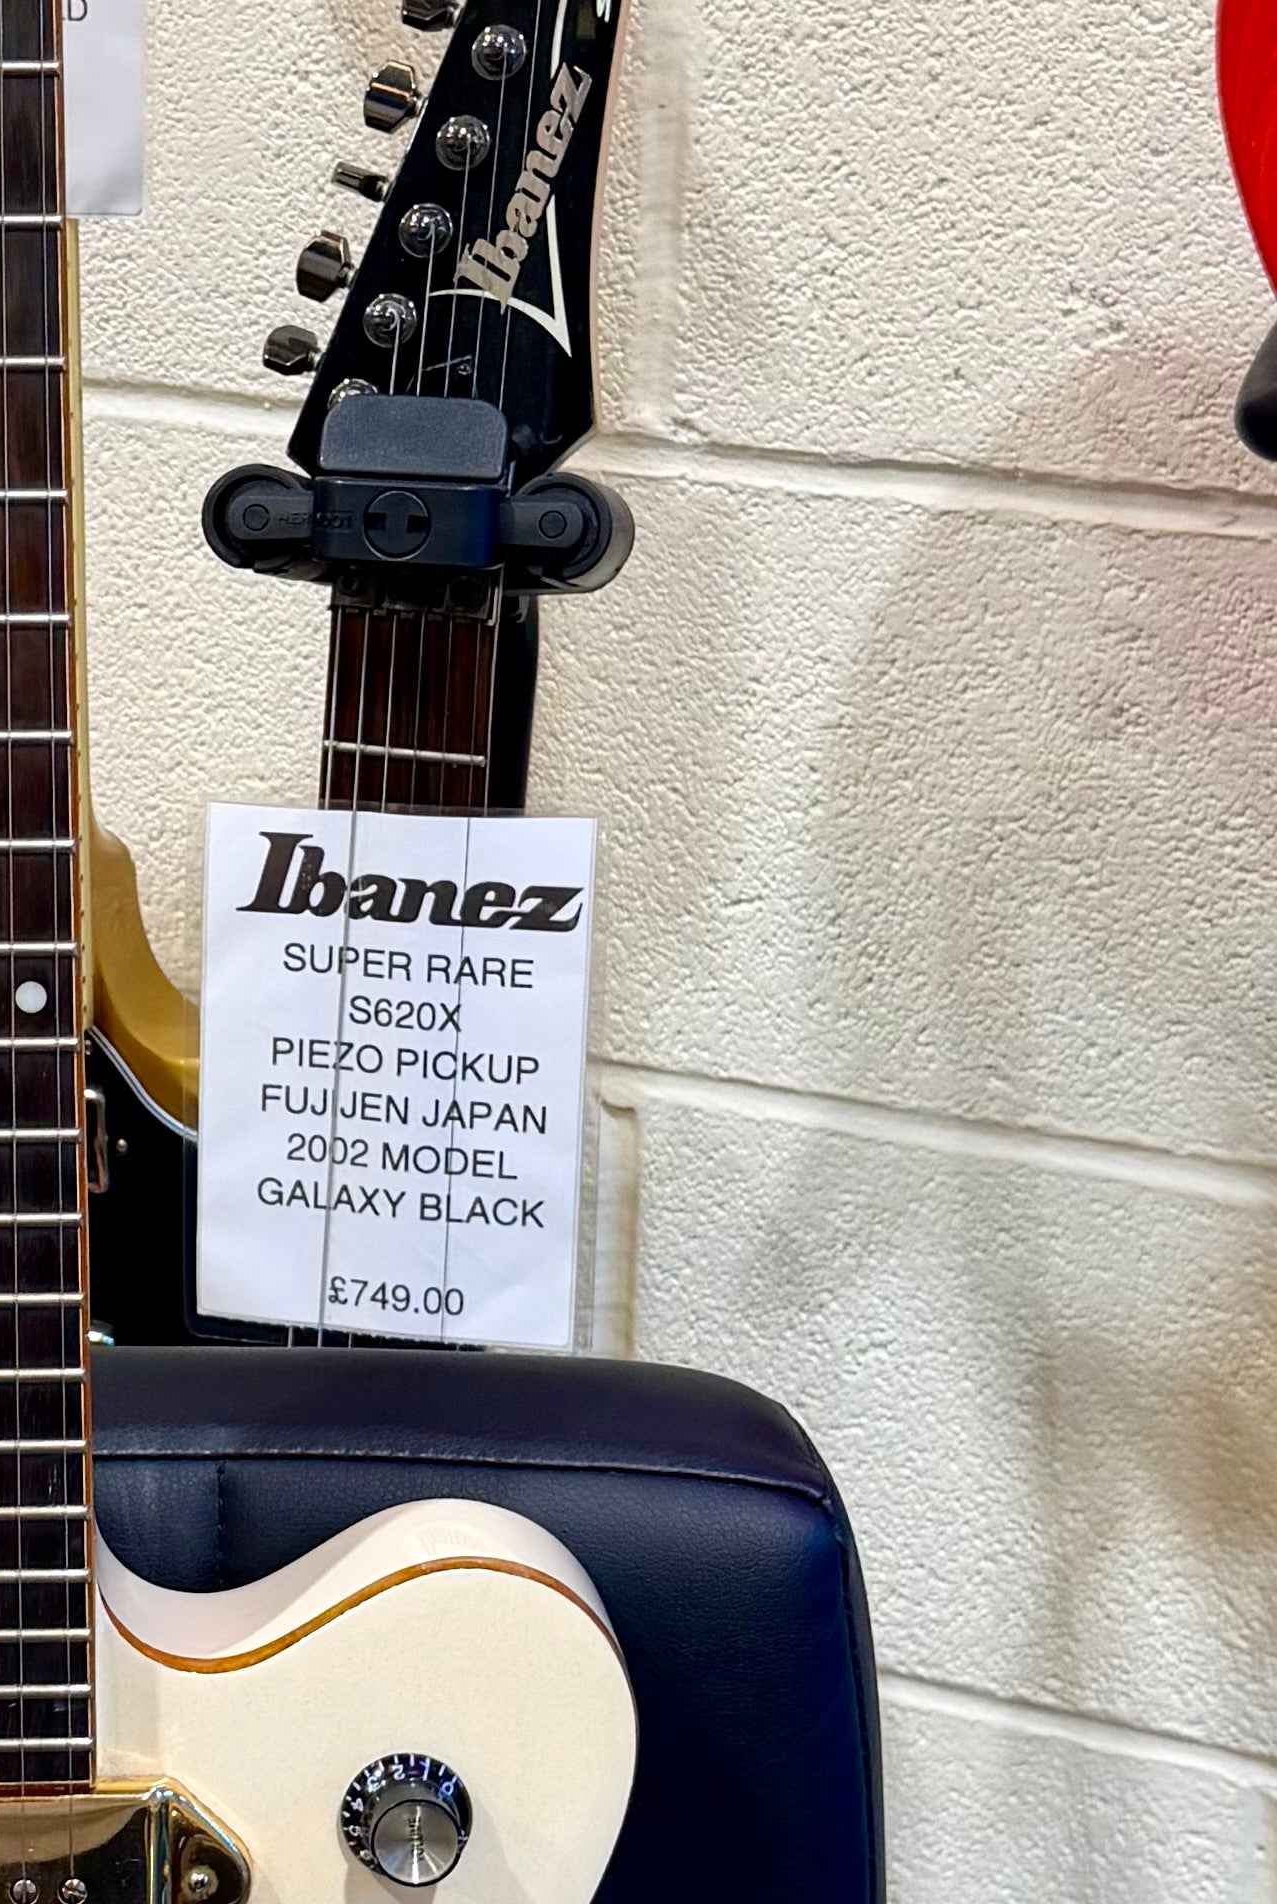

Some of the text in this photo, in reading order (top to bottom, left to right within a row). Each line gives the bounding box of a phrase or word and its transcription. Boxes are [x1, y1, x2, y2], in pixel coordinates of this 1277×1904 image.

[452, 63, 593, 315] Ibanez
[236, 830, 584, 933] Ibanez
[283, 942, 535, 989] SUPER RARE
[348, 995, 462, 1033] S620X
[271, 1037, 539, 1085] PIEZO PICKUP
[422, 1099, 547, 1135] JAPAN
[287, 1132, 518, 1180] 2002 MODEL
[257, 1177, 545, 1229] GALAXY BLACK
[328, 1277, 464, 1316] £749.00
